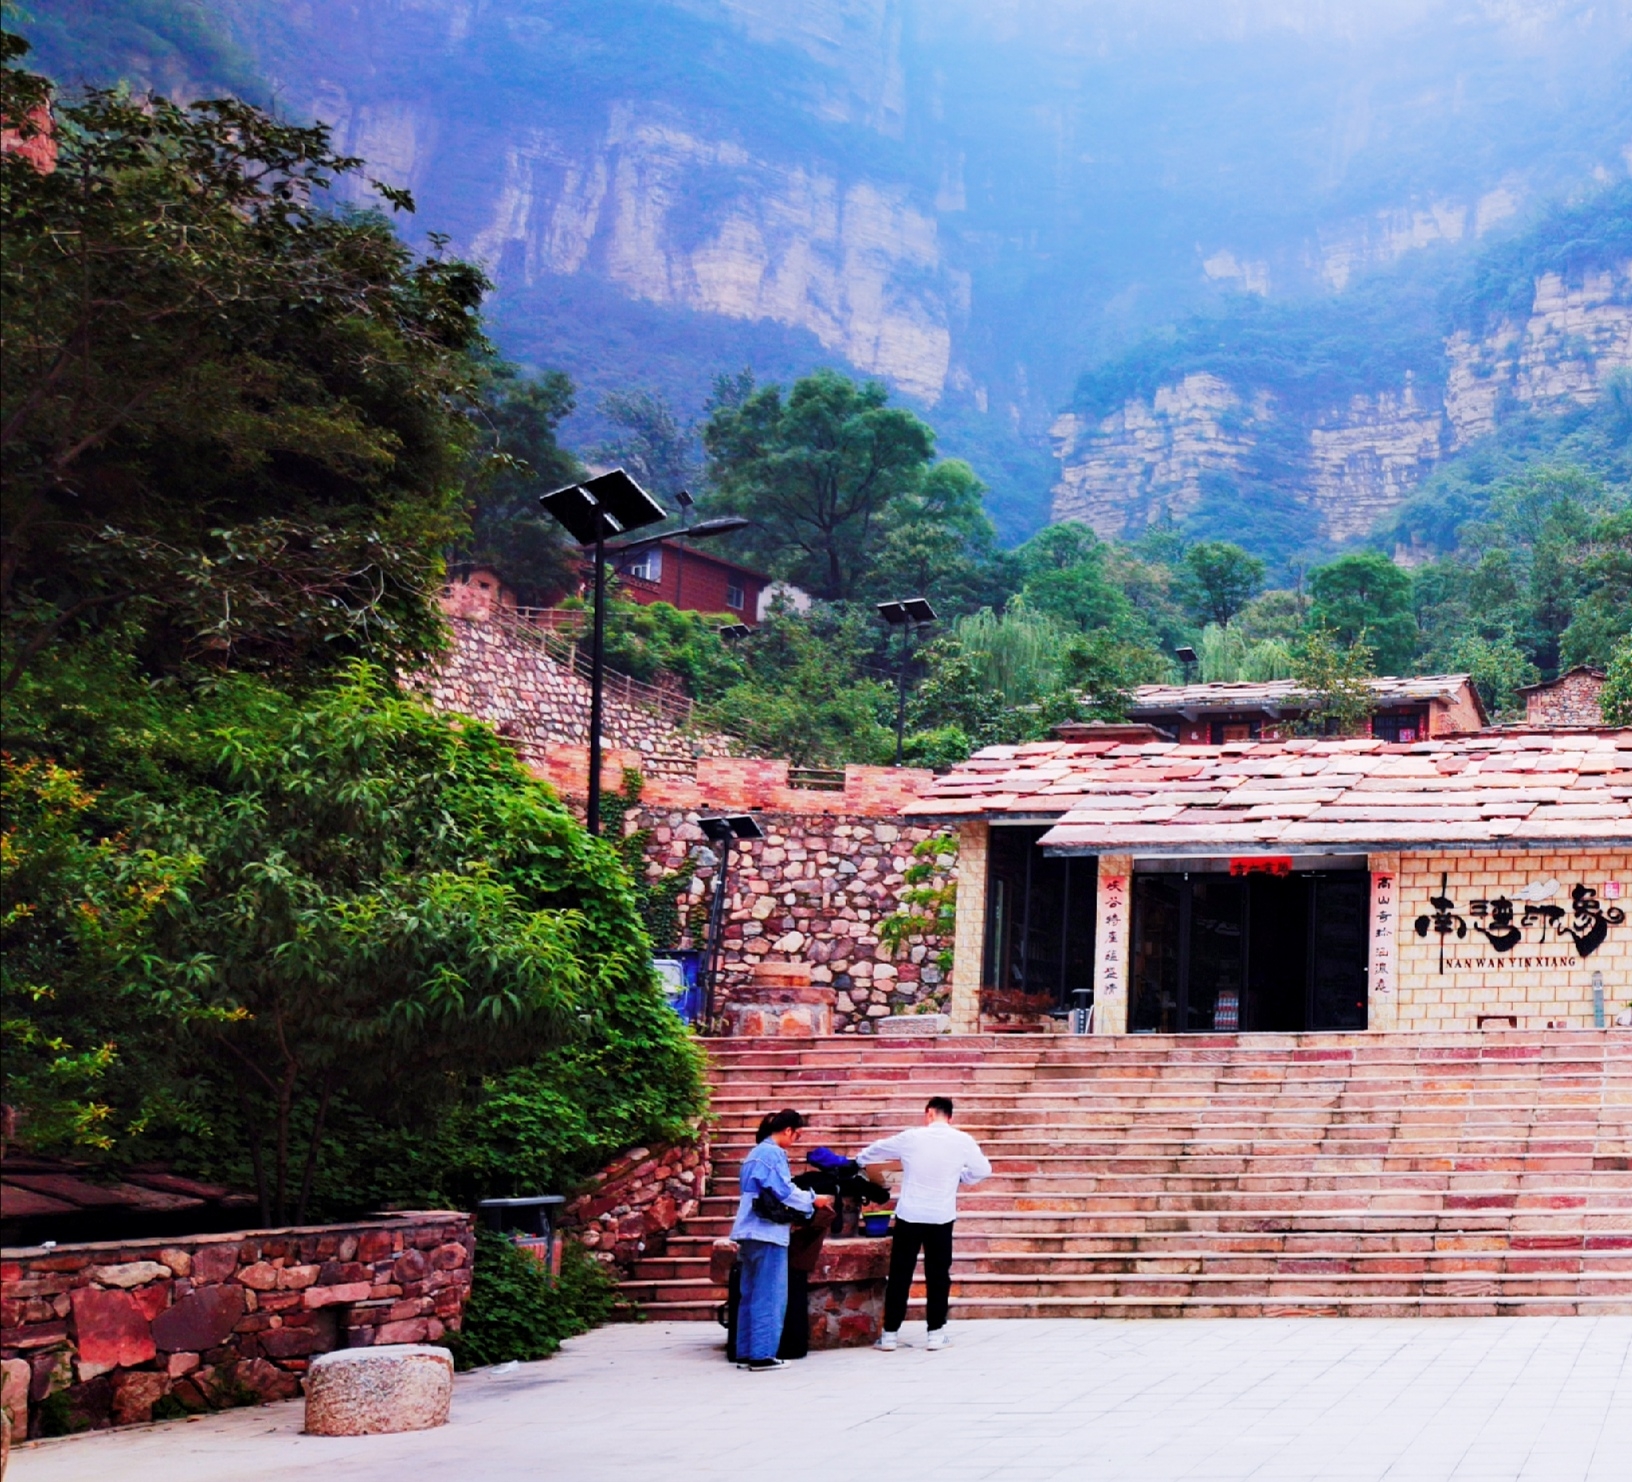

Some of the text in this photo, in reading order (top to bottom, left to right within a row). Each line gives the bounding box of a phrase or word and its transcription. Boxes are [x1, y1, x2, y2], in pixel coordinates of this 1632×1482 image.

[1445, 957, 1576, 968] NAN WAN YIN XIANG
